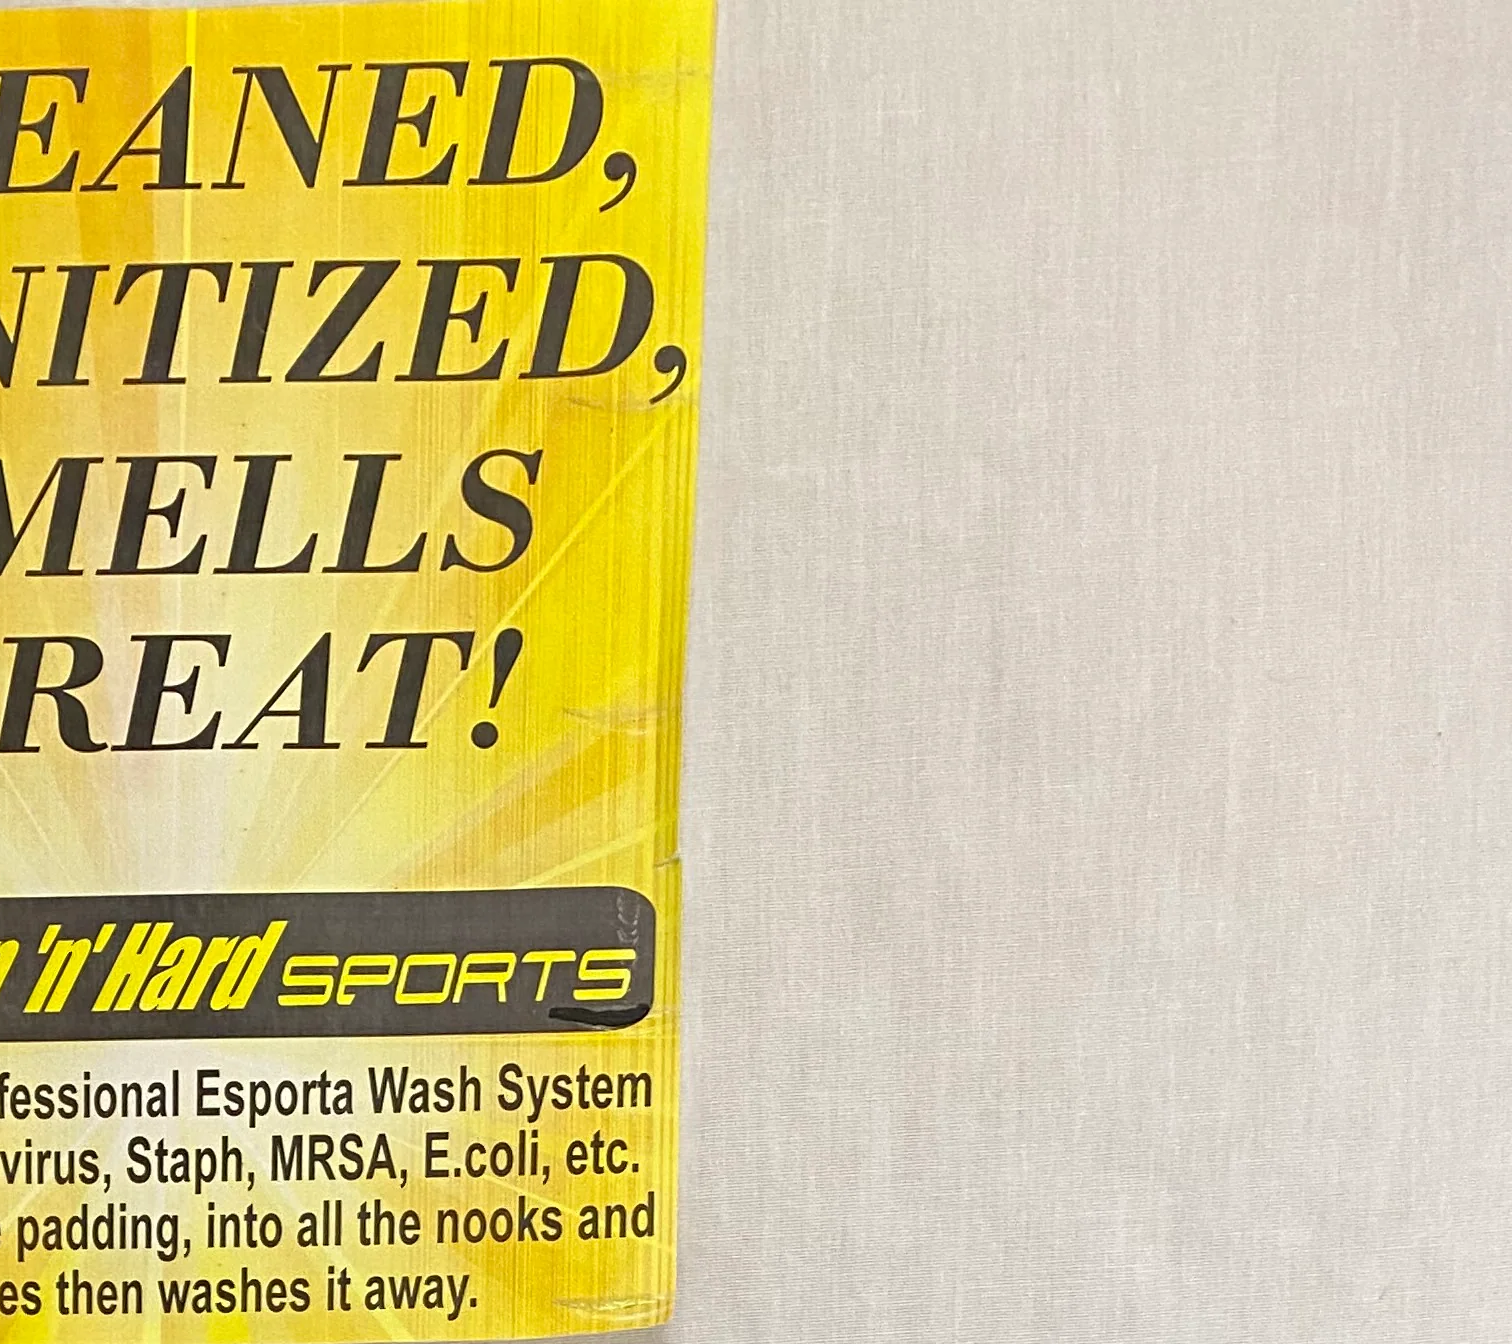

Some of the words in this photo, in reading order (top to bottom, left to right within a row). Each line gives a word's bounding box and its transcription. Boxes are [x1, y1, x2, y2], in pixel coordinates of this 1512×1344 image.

[23, 922, 117, 1014] 'n'
[91, 919, 288, 1012] Hard
[278, 948, 637, 1006] SPORTS
[196, 1069, 354, 1129] Esporta
[367, 1065, 481, 1114] Wash
[497, 1062, 652, 1124] System
[126, 1135, 255, 1195] Staph,
[271, 1133, 408, 1189] MRSA,
[424, 1129, 550, 1186] E.coli,
[566, 1129, 639, 1176] etc.
[17, 1202, 191, 1263] padding,
[207, 1201, 283, 1249] into
[296, 1199, 342, 1248] all
[357, 1198, 421, 1246] the
[436, 1195, 563, 1244] nooks
[578, 1191, 656, 1241] and
[55, 1269, 143, 1316] then
[157, 1266, 311, 1314] washes
[327, 1265, 352, 1312] it
[364, 1274, 478, 1326] away.
